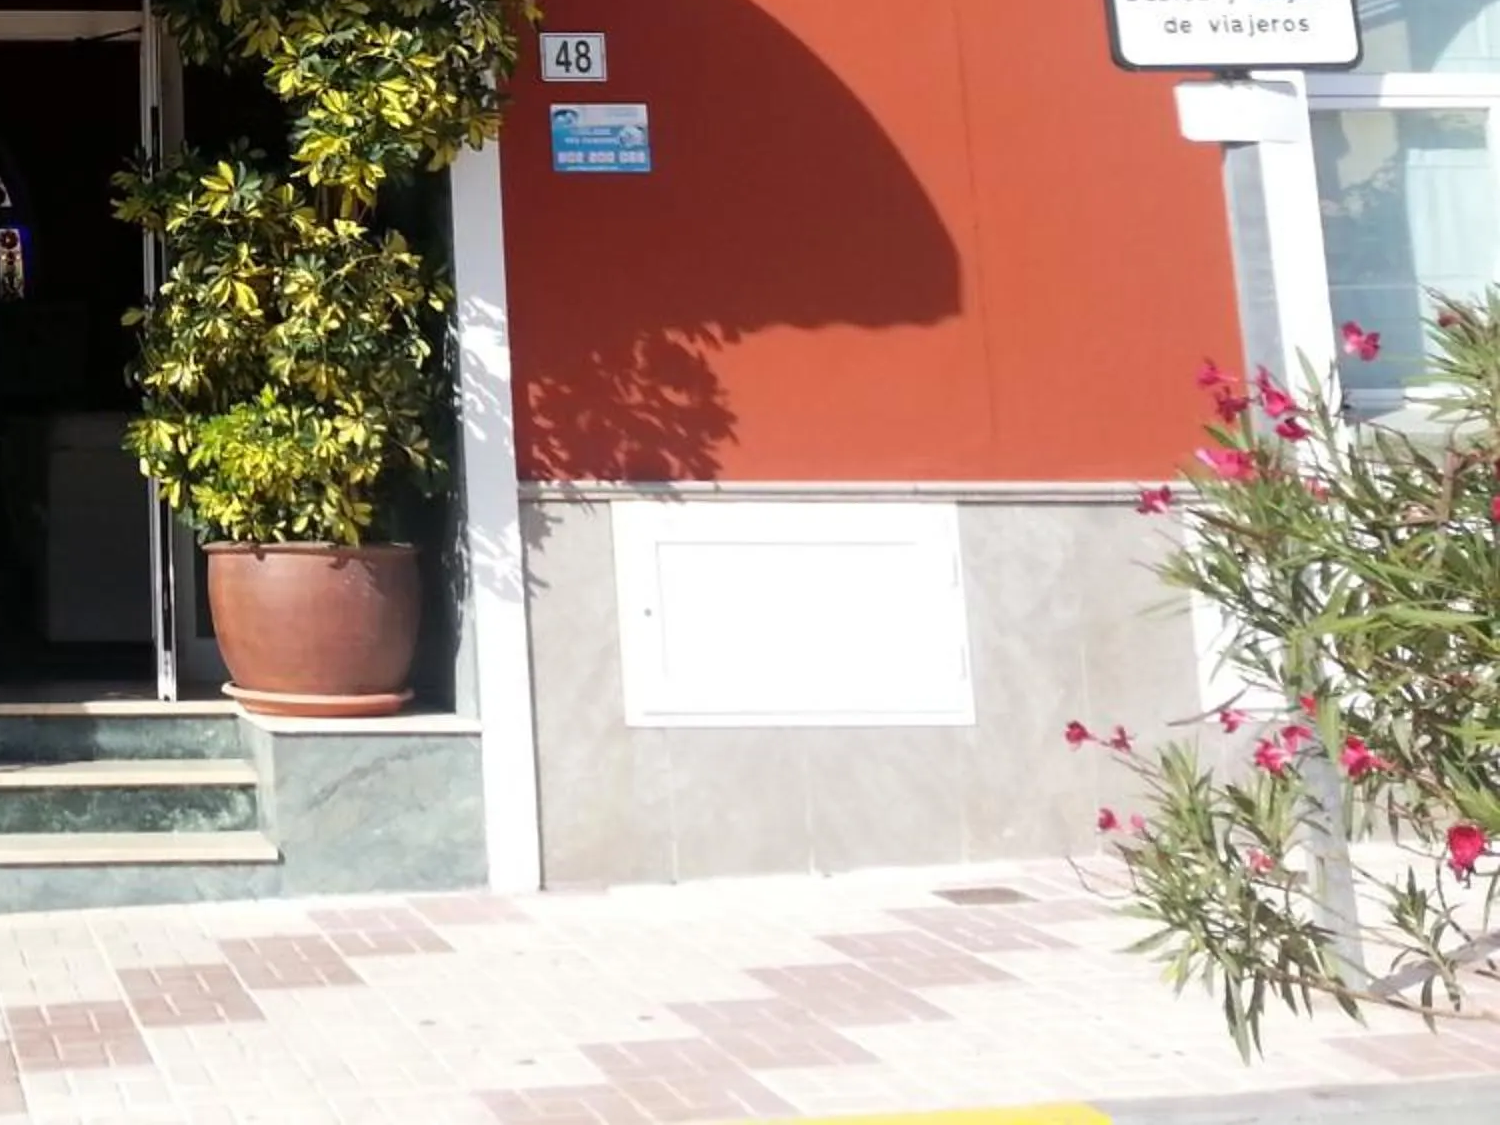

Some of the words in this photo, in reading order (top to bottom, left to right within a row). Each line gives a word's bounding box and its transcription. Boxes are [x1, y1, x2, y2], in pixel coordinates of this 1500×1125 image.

[1163, 16, 1193, 34] de
[1208, 14, 1310, 37] viajeros
[555, 40, 592, 73] 48
